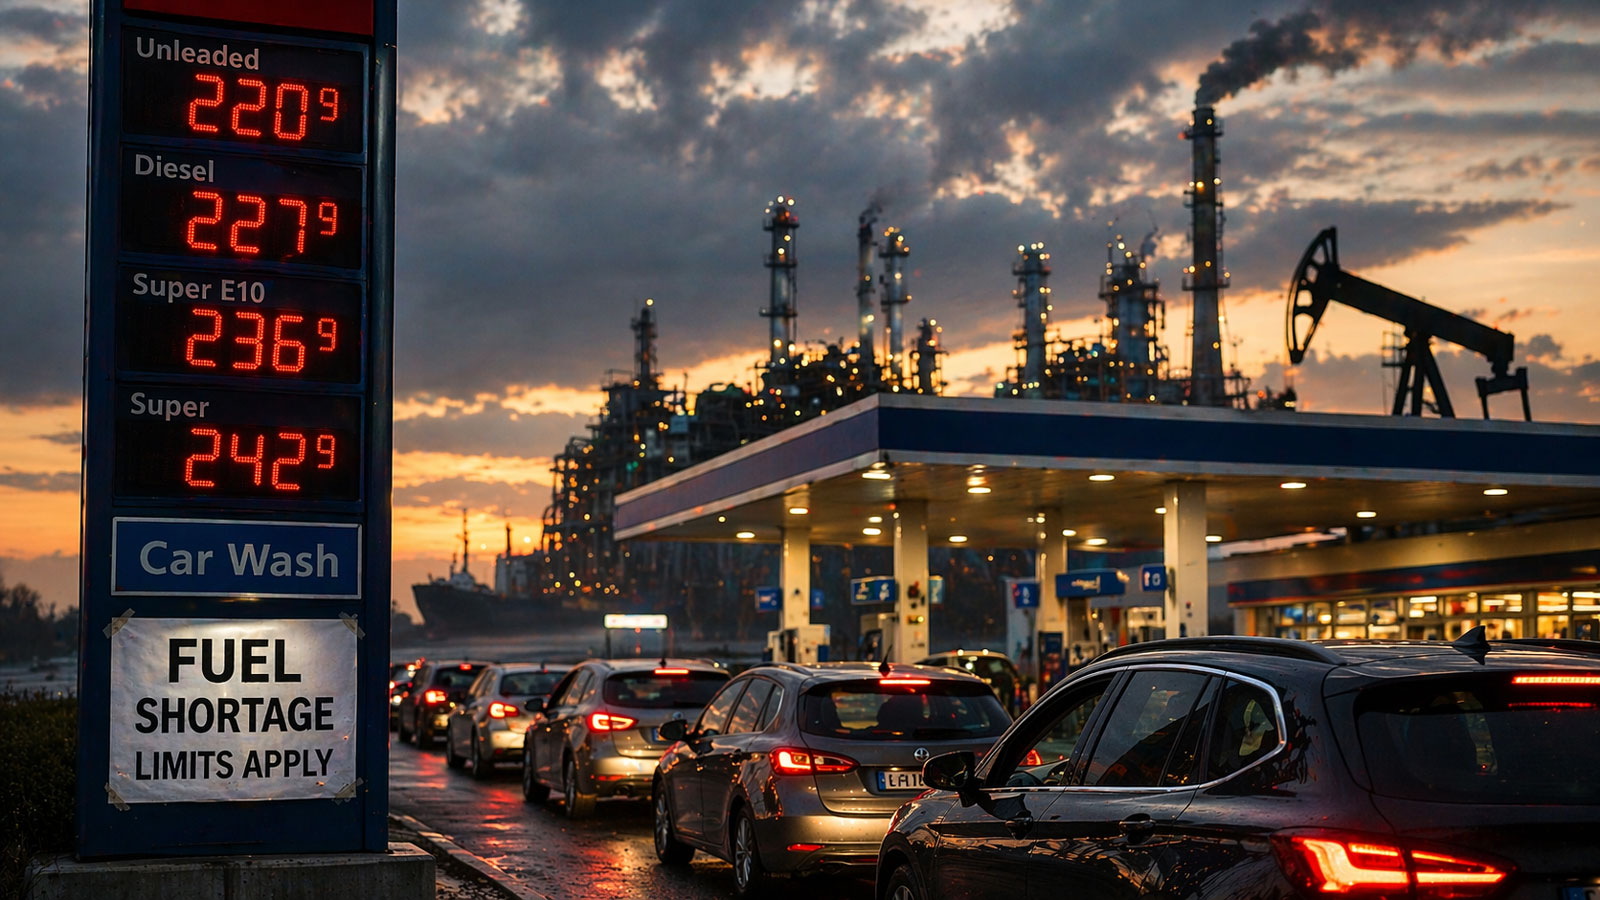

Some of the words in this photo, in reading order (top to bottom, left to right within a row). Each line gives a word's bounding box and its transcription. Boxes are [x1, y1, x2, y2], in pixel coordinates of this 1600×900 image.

[136, 36, 259, 71] Unleaded
[135, 154, 214, 183] Diesel
[132, 273, 212, 303] Super
[221, 279, 265, 303] E10
[130, 392, 209, 421] Super
[140, 540, 213, 575] Car
[227, 543, 339, 577] Wash
[168, 638, 302, 684] FUEL
[134, 696, 334, 734] SHORTAGE
[135, 750, 234, 781] LIMITS
[242, 748, 334, 779] APPLY
